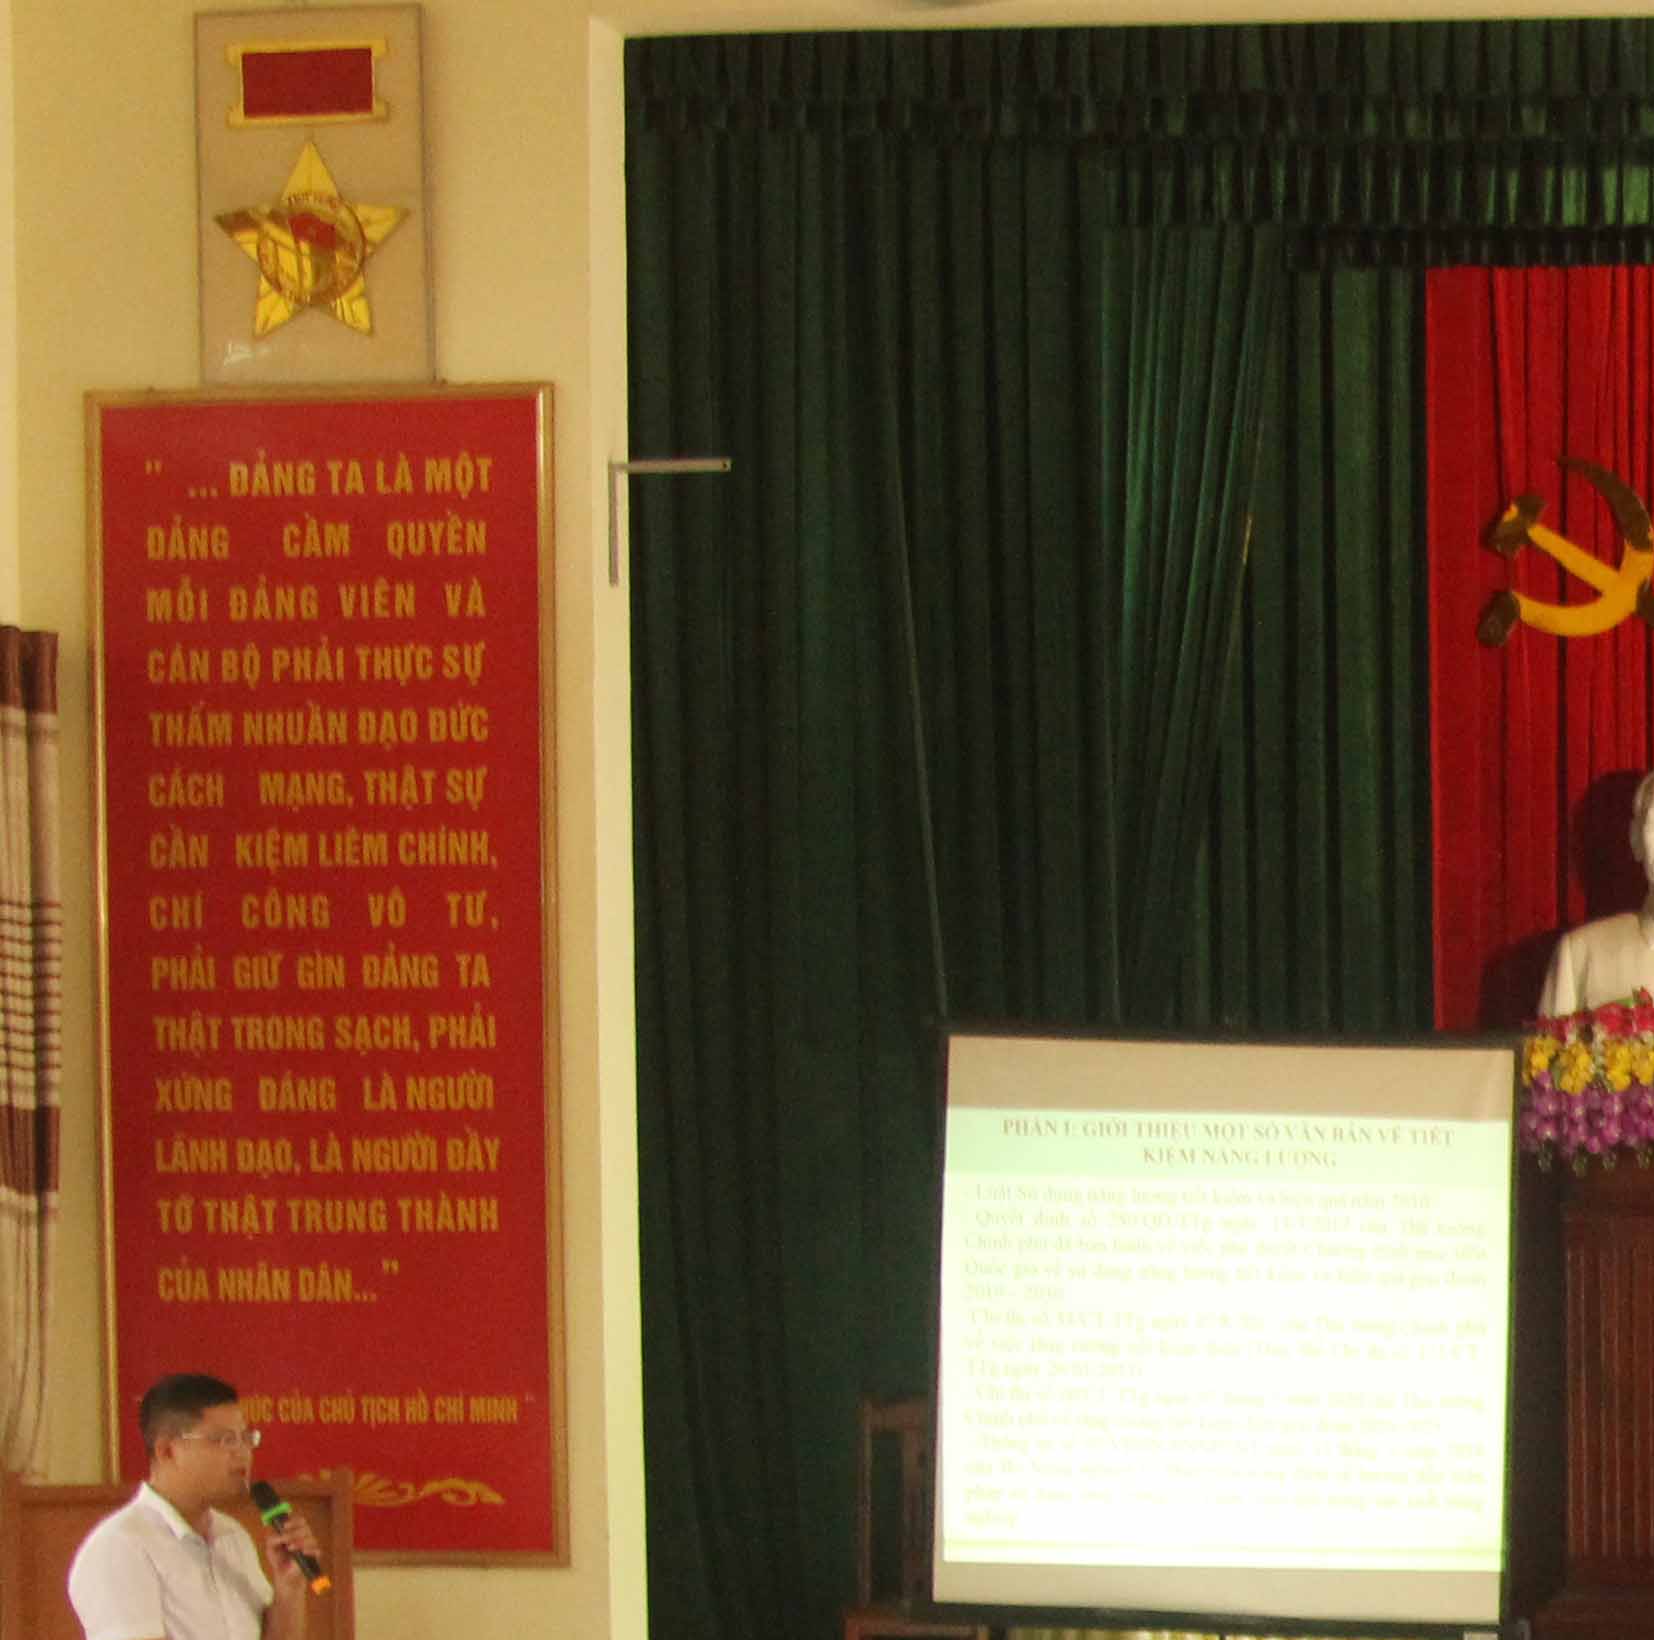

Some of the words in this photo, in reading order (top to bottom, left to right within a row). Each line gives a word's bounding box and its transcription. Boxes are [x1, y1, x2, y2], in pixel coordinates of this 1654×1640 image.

[229, 449, 315, 496] ĐẢNG
[327, 459, 364, 495] TA
[376, 453, 414, 494] LÀ
[425, 451, 492, 499] MỘT
[147, 515, 229, 560] ĐẢNG
[229, 575, 318, 621] ĐẢNG
[339, 577, 415, 619] VIÊN
[445, 577, 486, 617] VÀ
[148, 642, 210, 683] CÁN
[221, 642, 261, 688] BỘ
[272, 636, 345, 682] PHẢI
[356, 643, 433, 686] THỰC
[443, 640, 485, 686] SỰ
[358, 708, 418, 750] ĐẠO
[149, 768, 224, 808] CÁCH
[259, 771, 354, 814] MẠNG,
[446, 766, 487, 810] SỰ
[236, 827, 308, 873] KIỆM
[319, 827, 388, 866] LIÊM
[398, 825, 497, 867] CHÍNH,
[241, 888, 330, 928] CÔNG
[368, 887, 406, 927] VÔ
[151, 944, 216, 991] PHẢI
[362, 943, 440, 988] ĐẢNG
[456, 953, 490, 988] TA
[231, 1015, 325, 1050] TRONG
[335, 1014, 420, 1055] SẠCH,
[429, 1002, 496, 1049] PHẢI
[258, 1071, 337, 1111] ĐÁNG
[363, 1072, 398, 1111] LÀ
[236, 1137, 301, 1178] ĐẠO,
[309, 1132, 343, 1173] LÀ
[286, 1199, 387, 1233] TRUNG
[398, 1192, 499, 1232] THÀNH
[158, 1257, 210, 1302] CỦA
[218, 1261, 292, 1301] NHÂN
